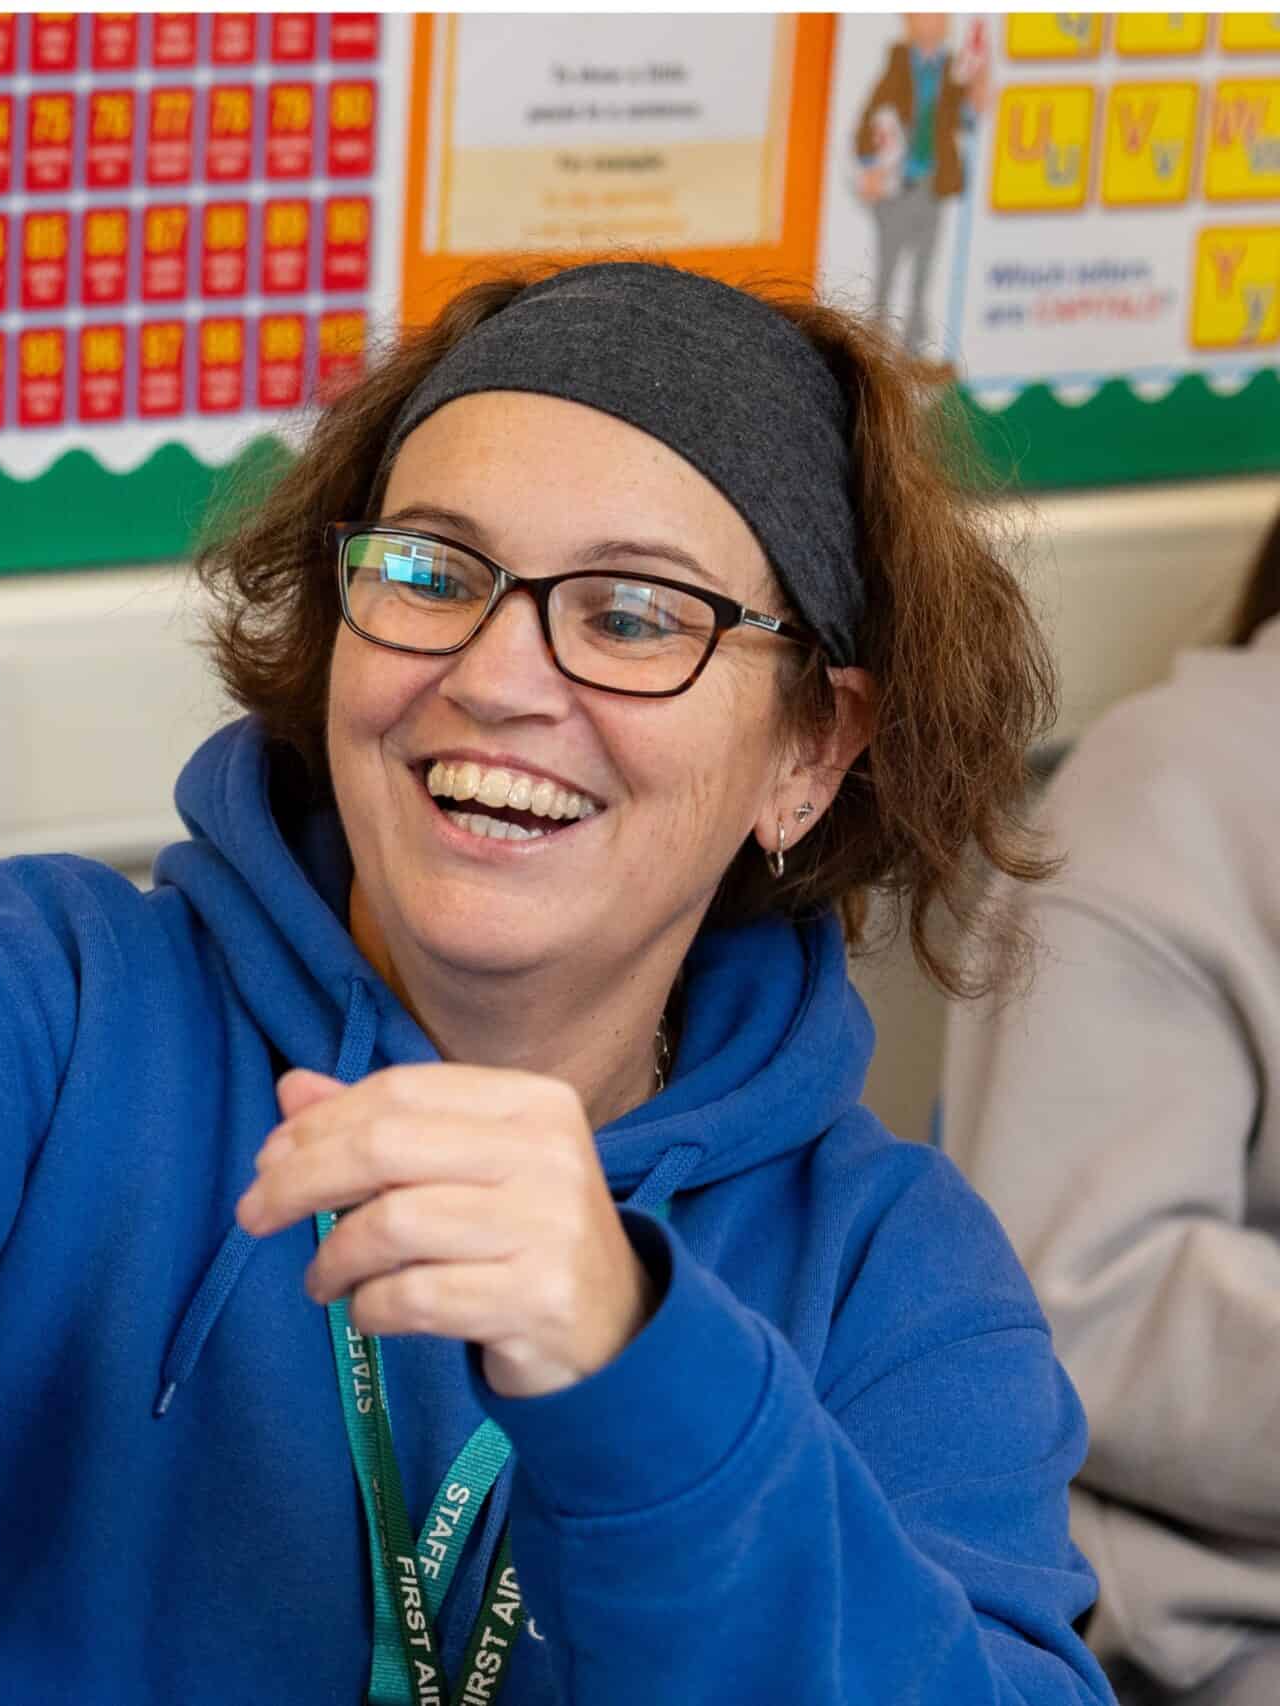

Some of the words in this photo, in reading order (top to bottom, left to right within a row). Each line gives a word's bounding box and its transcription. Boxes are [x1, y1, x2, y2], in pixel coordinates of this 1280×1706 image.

[346, 1326, 373, 1414] STAFF
[419, 1482, 470, 1580] STAFF
[396, 1556, 432, 1653] FIRST
[461, 1625, 508, 1706] IRST
